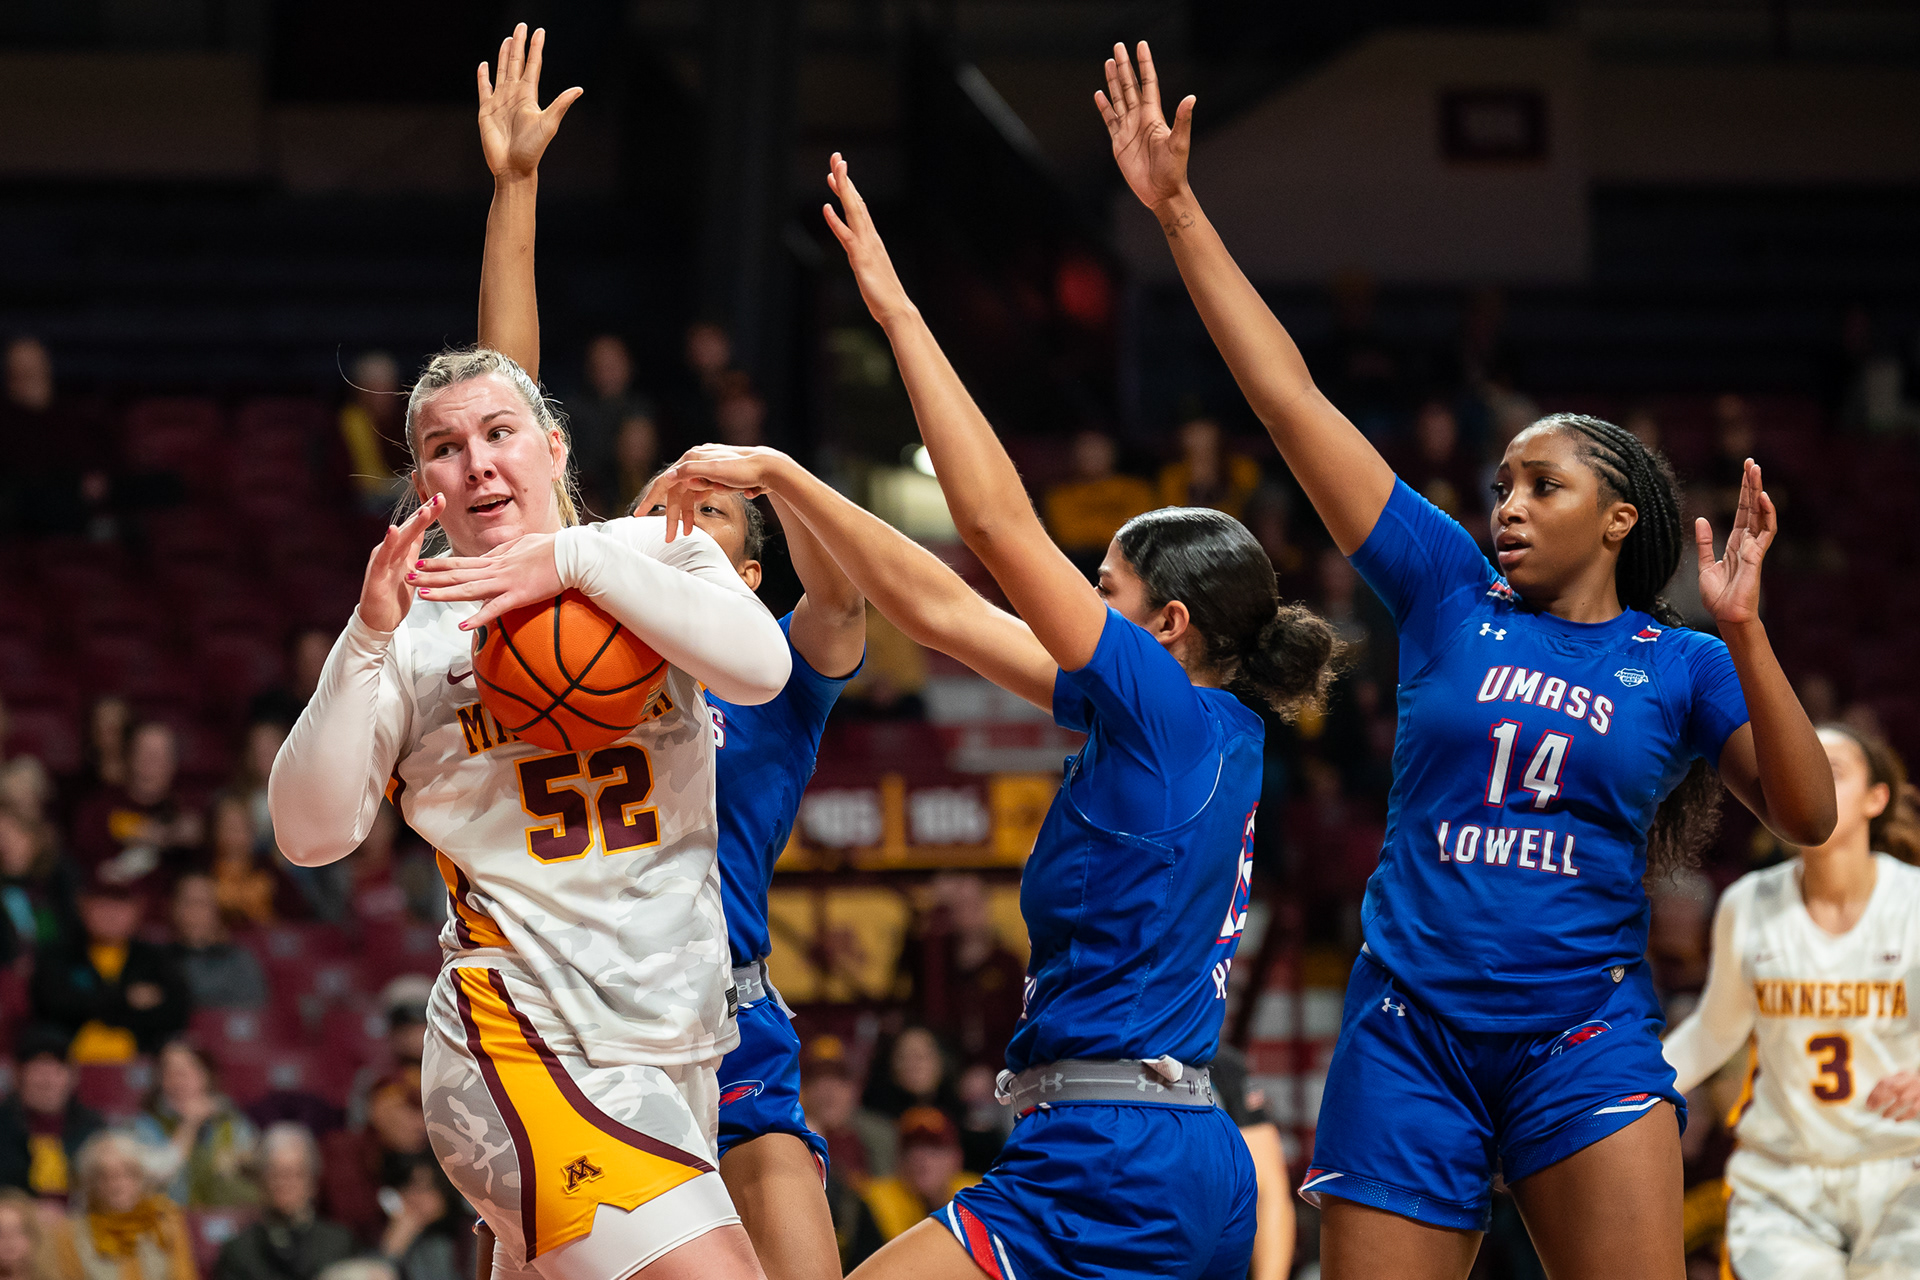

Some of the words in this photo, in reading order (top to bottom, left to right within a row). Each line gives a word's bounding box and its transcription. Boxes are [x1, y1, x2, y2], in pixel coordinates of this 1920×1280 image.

[1476, 665, 1615, 735] UMASS
[1484, 717, 1574, 812] 14
[513, 741, 661, 865] 52
[1437, 819, 1580, 878] LOWELL
[1753, 978, 1908, 1018] MINNESOTA
[1806, 1029, 1857, 1106] 3
[562, 1155, 604, 1194] M
